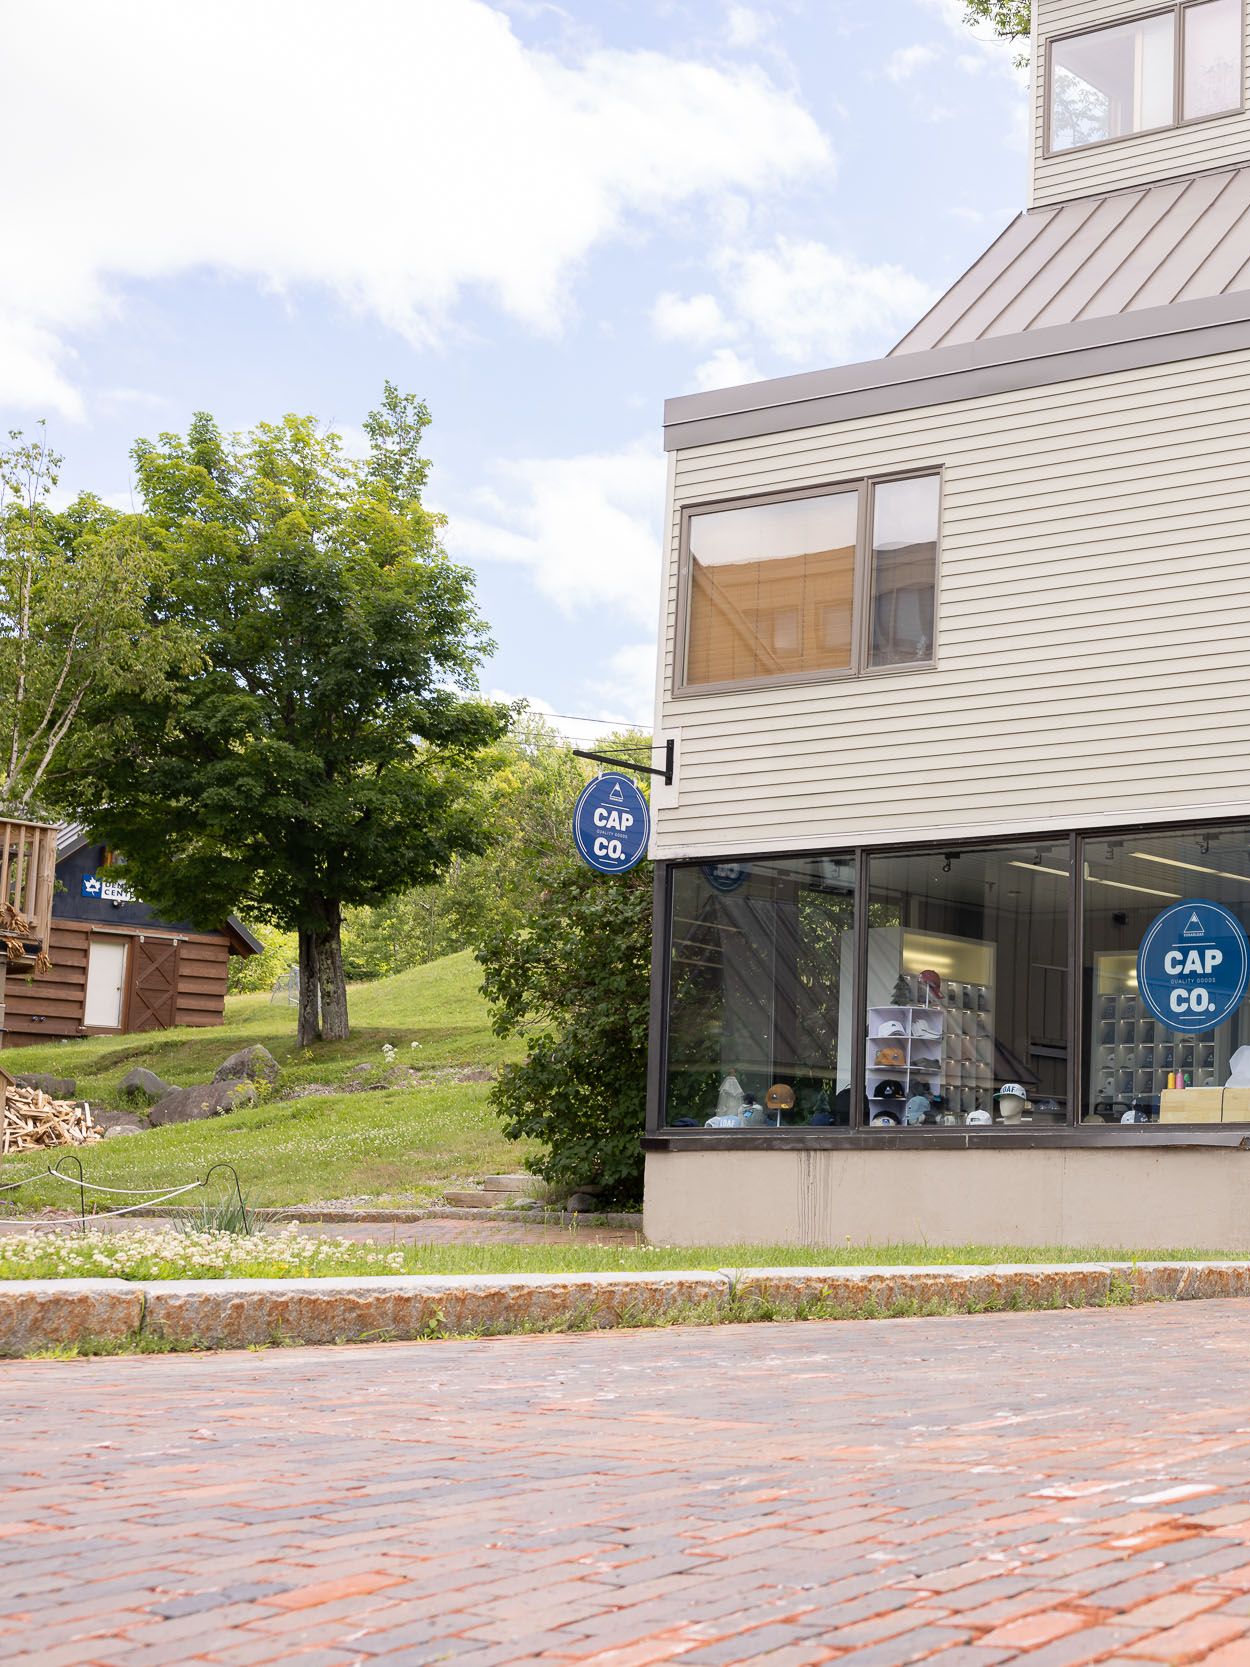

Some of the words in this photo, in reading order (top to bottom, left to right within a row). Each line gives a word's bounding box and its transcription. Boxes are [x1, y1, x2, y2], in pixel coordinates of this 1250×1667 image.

[593, 807, 634, 832] CAP
[593, 836, 626, 860] CO.
[1164, 949, 1223, 975] CAP
[1169, 987, 1216, 1013] CO.
